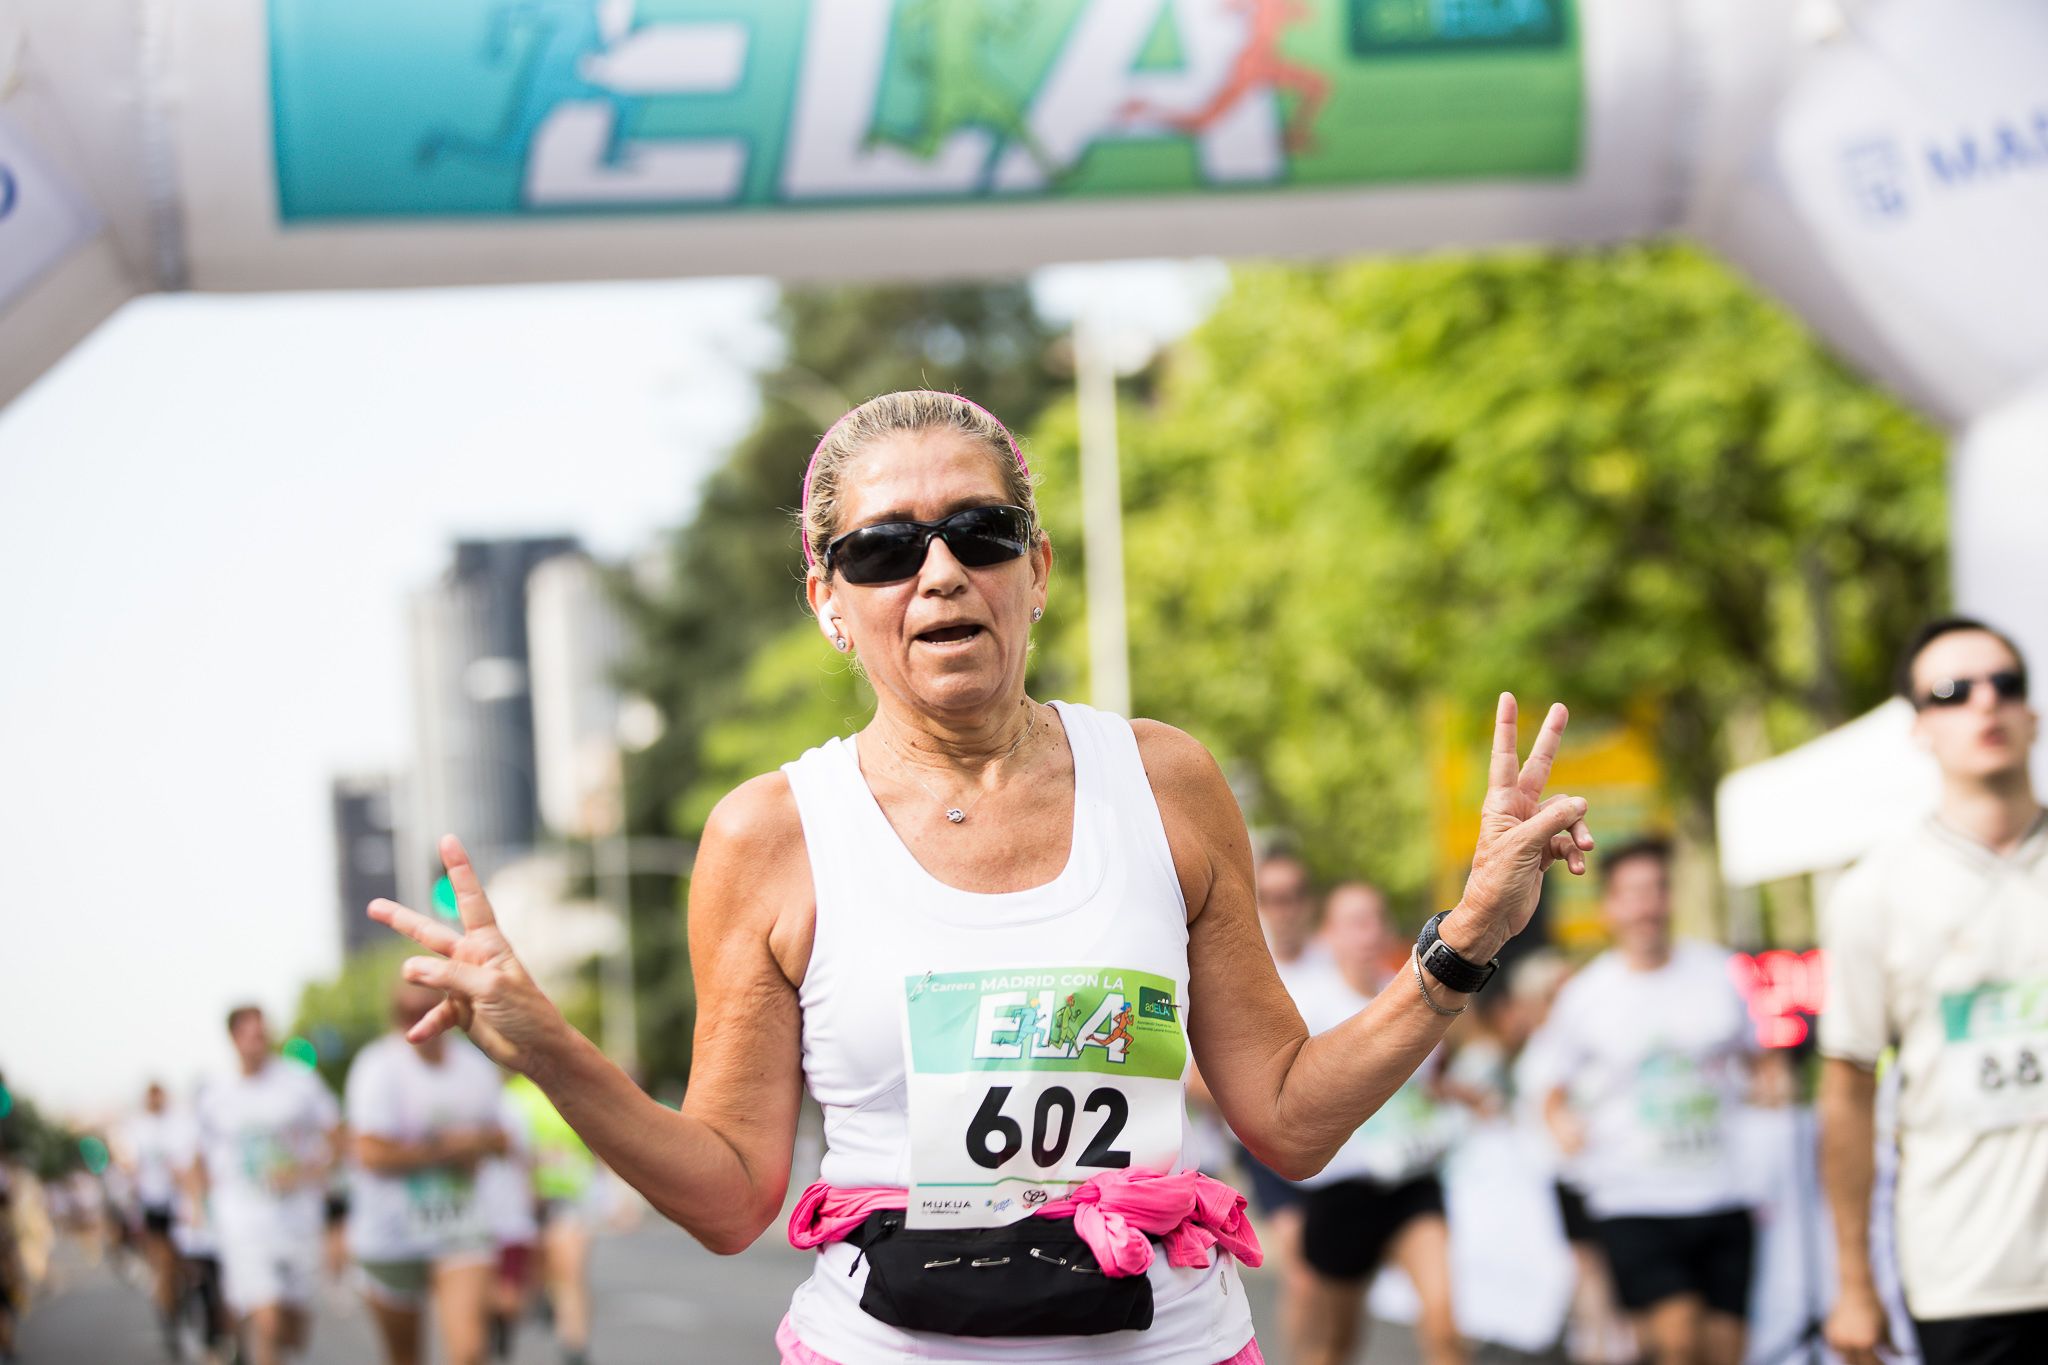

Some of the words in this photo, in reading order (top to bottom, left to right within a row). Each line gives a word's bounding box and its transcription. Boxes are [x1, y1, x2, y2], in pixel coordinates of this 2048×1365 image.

[930, 981, 976, 993] Carrera
[980, 974, 1056, 992] MADRID
[1060, 973, 1099, 988] CON
[1102, 975, 1124, 991] LA
[971, 990, 1127, 1065] ELA
[965, 1085, 1131, 1170] 602
[922, 1200, 972, 1209] MUKUA
